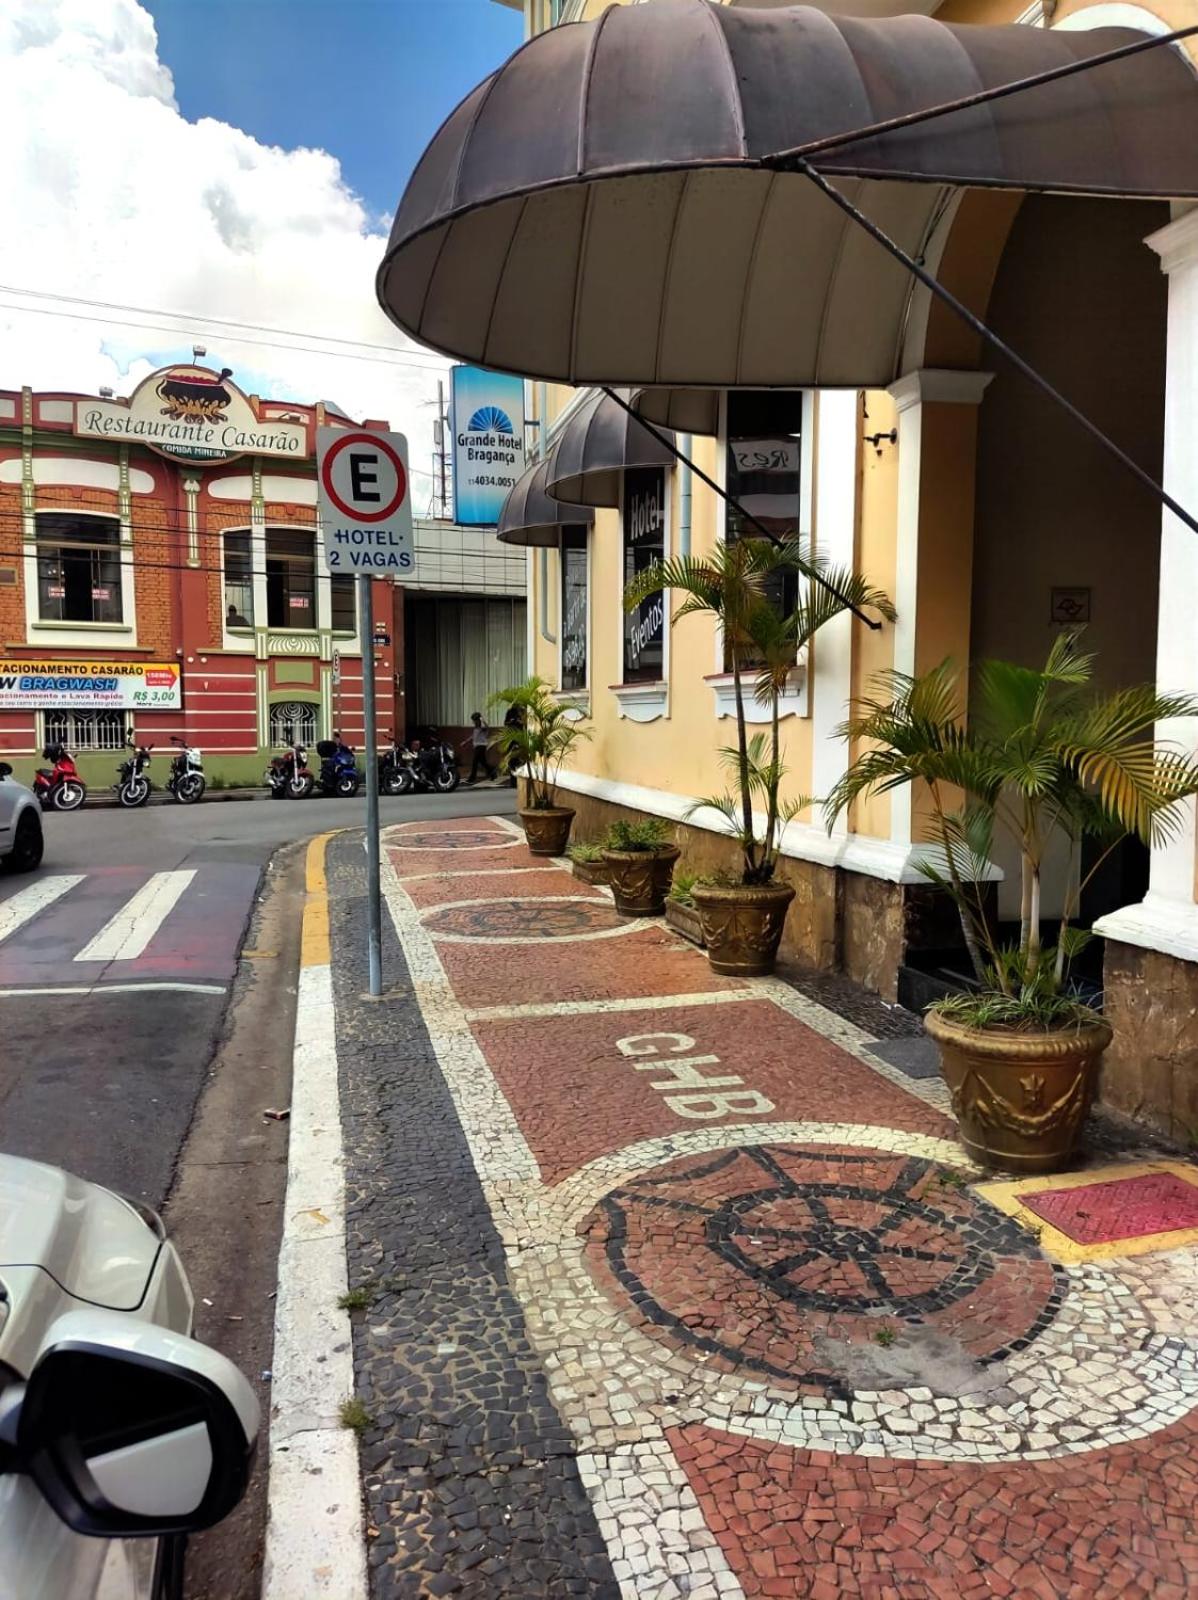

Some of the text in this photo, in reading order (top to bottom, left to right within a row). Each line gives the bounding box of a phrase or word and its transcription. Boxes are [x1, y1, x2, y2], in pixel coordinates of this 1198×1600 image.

[85, 410, 299, 452] Restaurante Casarão
[458, 433, 522, 451] Grande Hotel
[162, 444, 226, 459] COMIDA MINEIRA
[467, 448, 515, 466] Bragança
[350, 453, 381, 503] E
[631, 480, 661, 541] Hotel
[329, 551, 411, 567] 2 VAGAS
[631, 598, 663, 660] Eventos
[91, 665, 144, 675] CASARÃO
[20, 677, 118, 691] BRAGWASH
[133, 691, 175, 702] R$ 3,00
[616, 1032, 776, 1120] GHB
